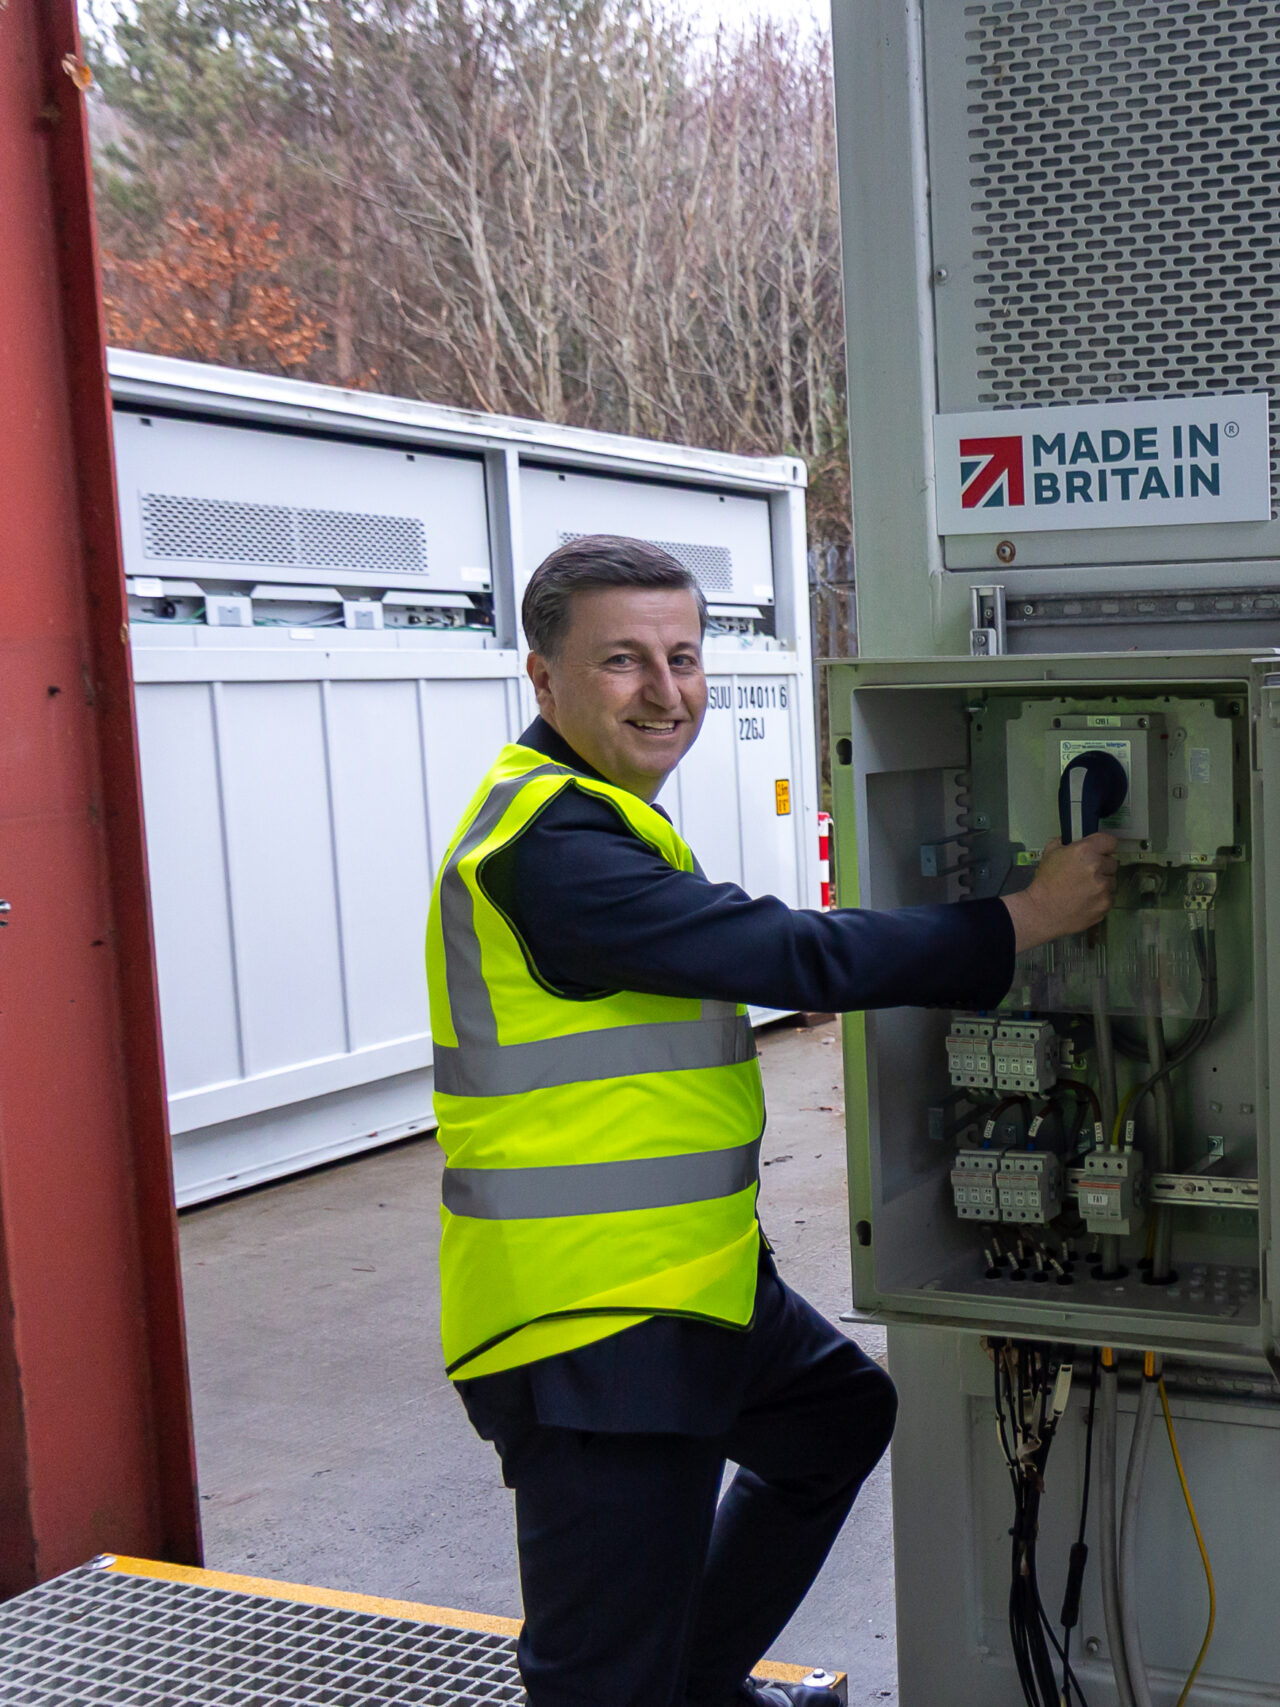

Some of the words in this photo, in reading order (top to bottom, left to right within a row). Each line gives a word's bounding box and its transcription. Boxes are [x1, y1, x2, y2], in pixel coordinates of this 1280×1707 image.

[1032, 427, 1159, 467] MADE
[1173, 423, 1219, 459] IN
[1034, 462, 1221, 505] BRITAIN
[707, 685, 732, 710] SUU
